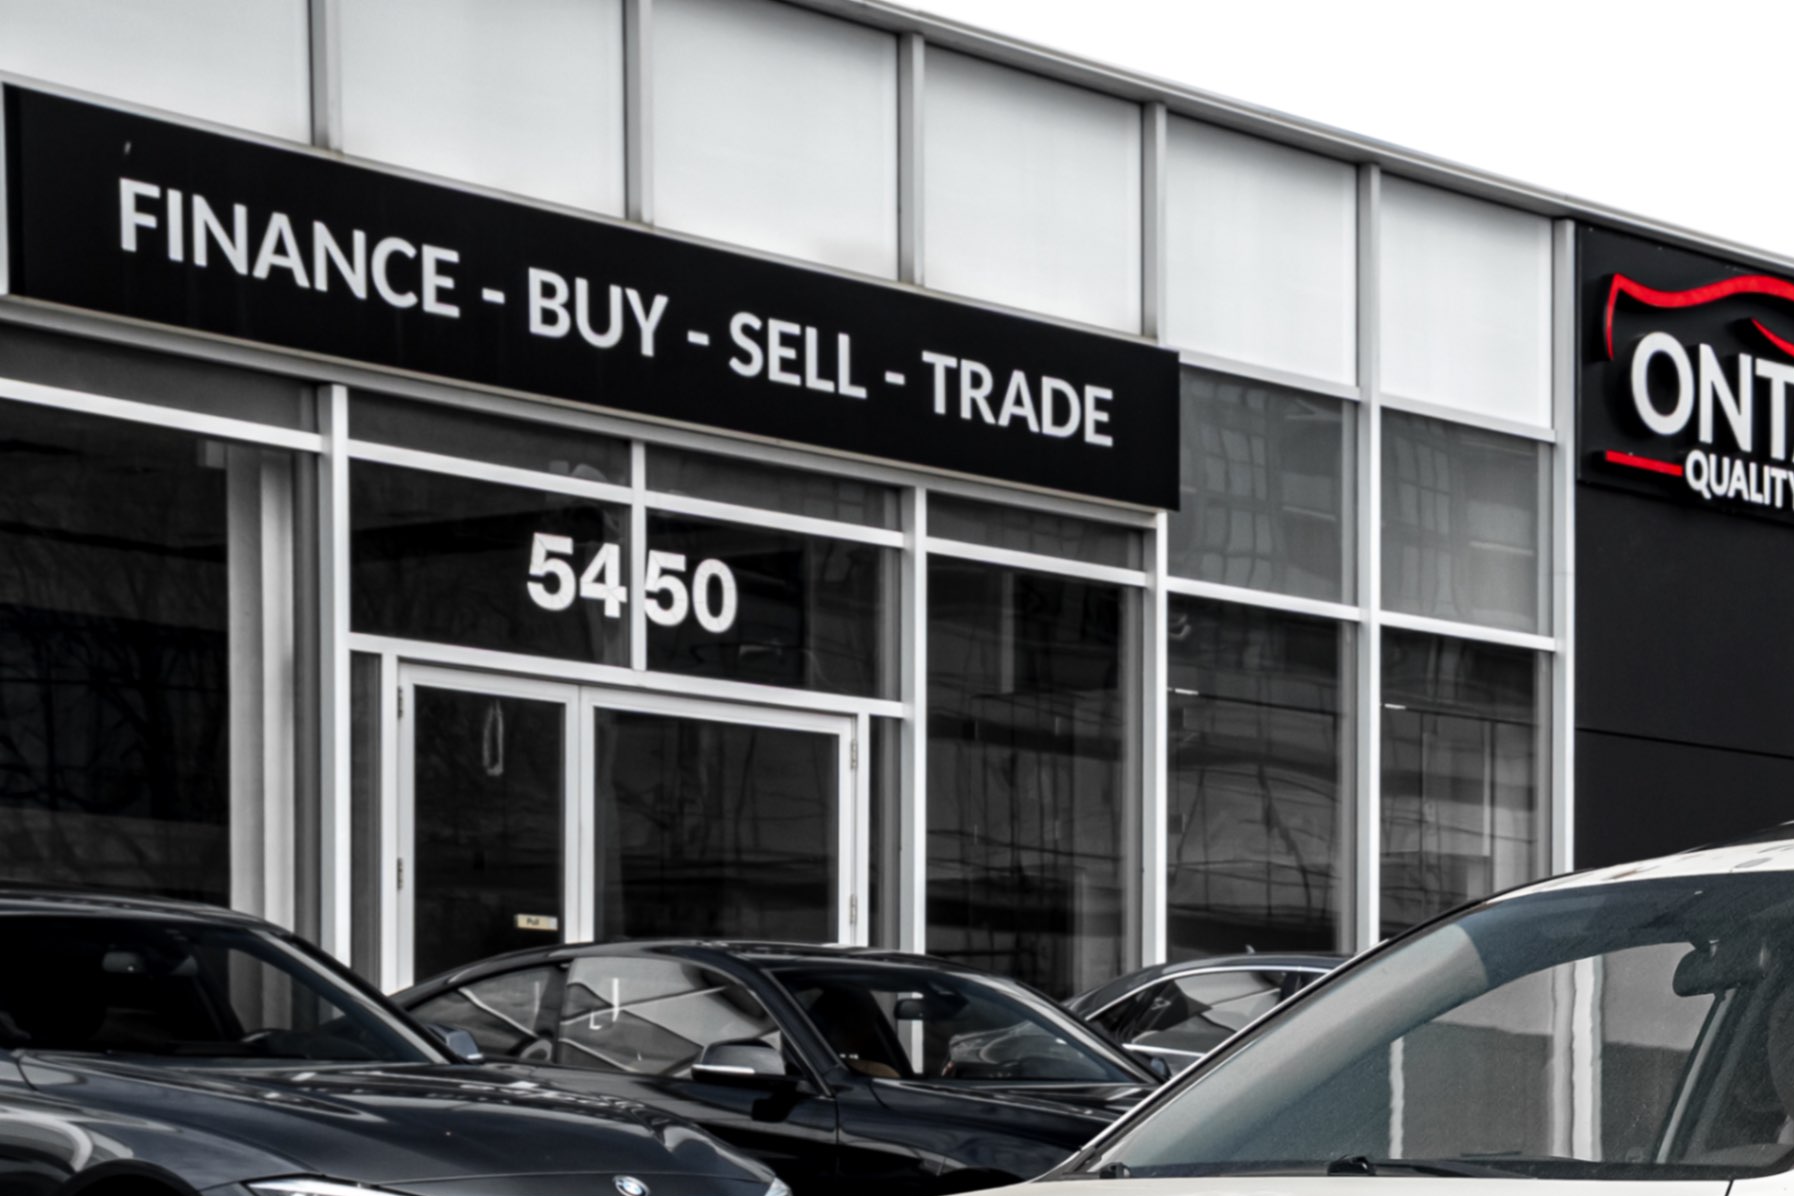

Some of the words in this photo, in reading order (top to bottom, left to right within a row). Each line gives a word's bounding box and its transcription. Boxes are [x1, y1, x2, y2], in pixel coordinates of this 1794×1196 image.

[119, 177, 460, 318] FINANCE
[528, 267, 669, 357] BUY
[729, 311, 867, 399] SELL
[921, 350, 1113, 447] TRADE
[527, 532, 738, 634] 5450
